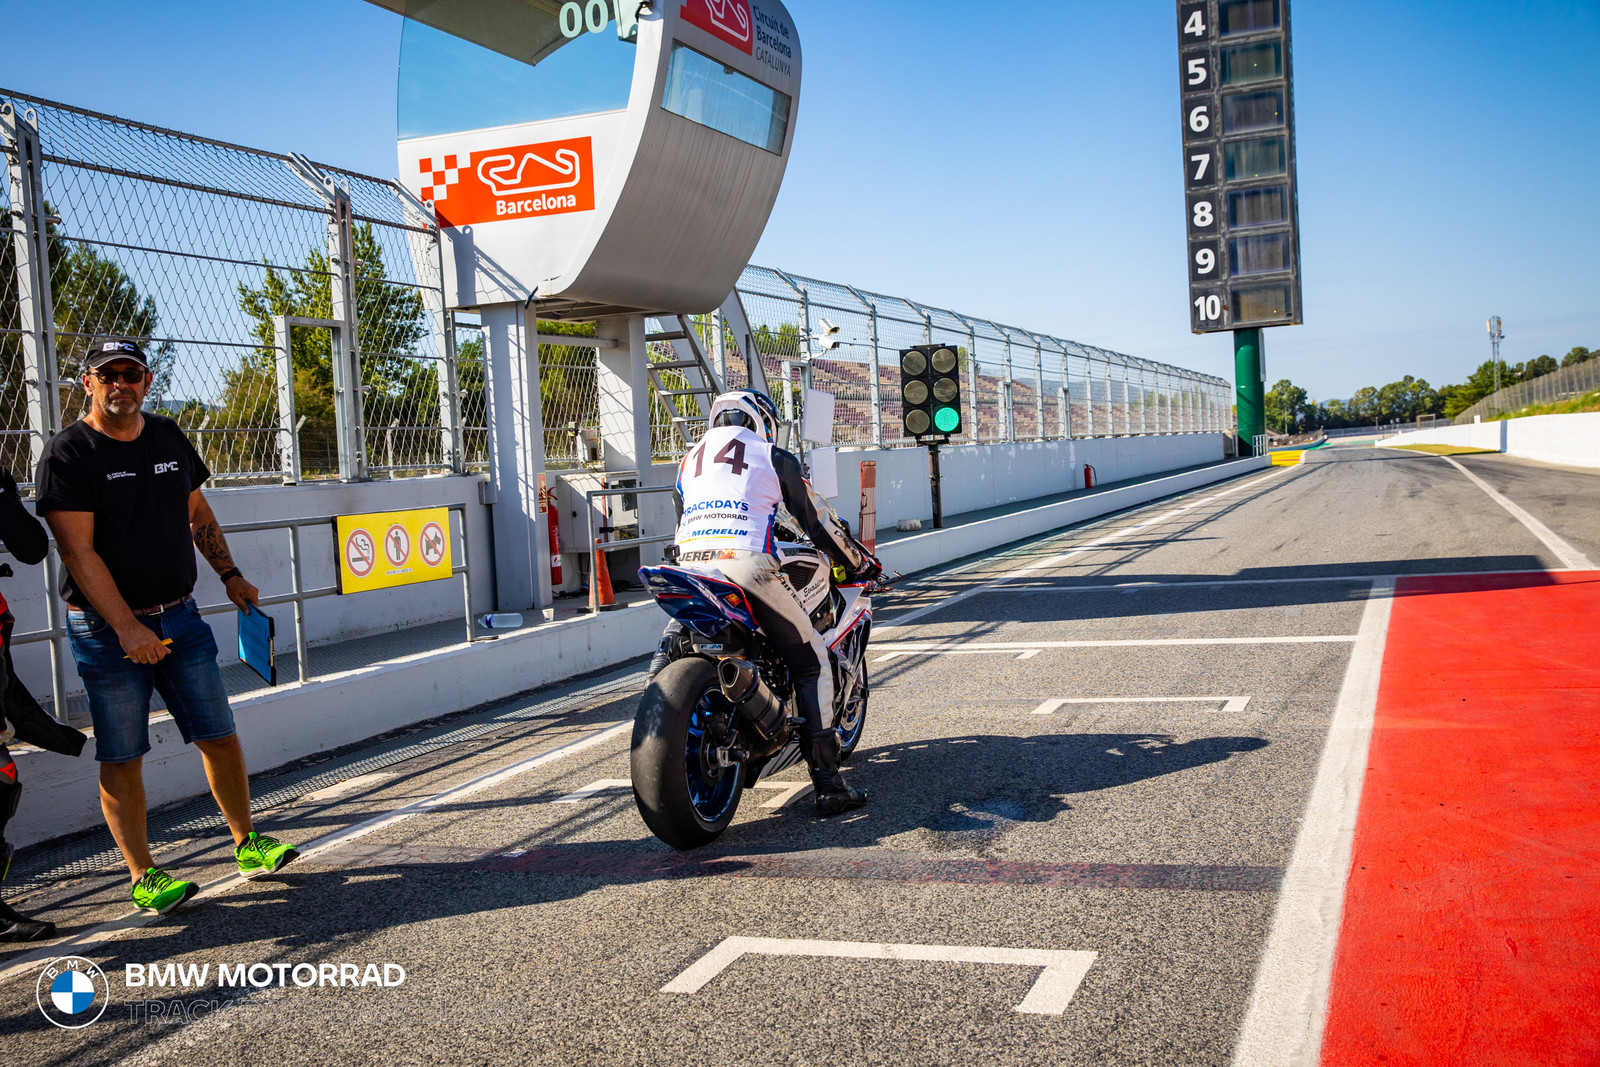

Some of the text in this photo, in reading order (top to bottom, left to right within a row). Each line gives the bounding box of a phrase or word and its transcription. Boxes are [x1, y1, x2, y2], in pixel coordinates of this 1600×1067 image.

[753, 5, 790, 39] Circuit de
[1184, 10, 1206, 36] 4
[756, 25, 792, 58] Barcelona
[755, 47, 791, 77] CATALUNYA
[1187, 58, 1207, 85] 5
[1189, 105, 1210, 132] 6
[1191, 153, 1210, 180] 7
[496, 193, 577, 216] Barcelona
[1193, 201, 1214, 227] 8
[1195, 248, 1215, 274] 9
[1194, 294, 1220, 321] 10
[102, 341, 135, 351] BMC
[154, 461, 179, 475] BMC
[692, 438, 749, 478] 14
[683, 500, 749, 517] TRACKDAYS
[687, 513, 748, 525] BMW MOTORRAD
[691, 528, 749, 537] MICHELIN
